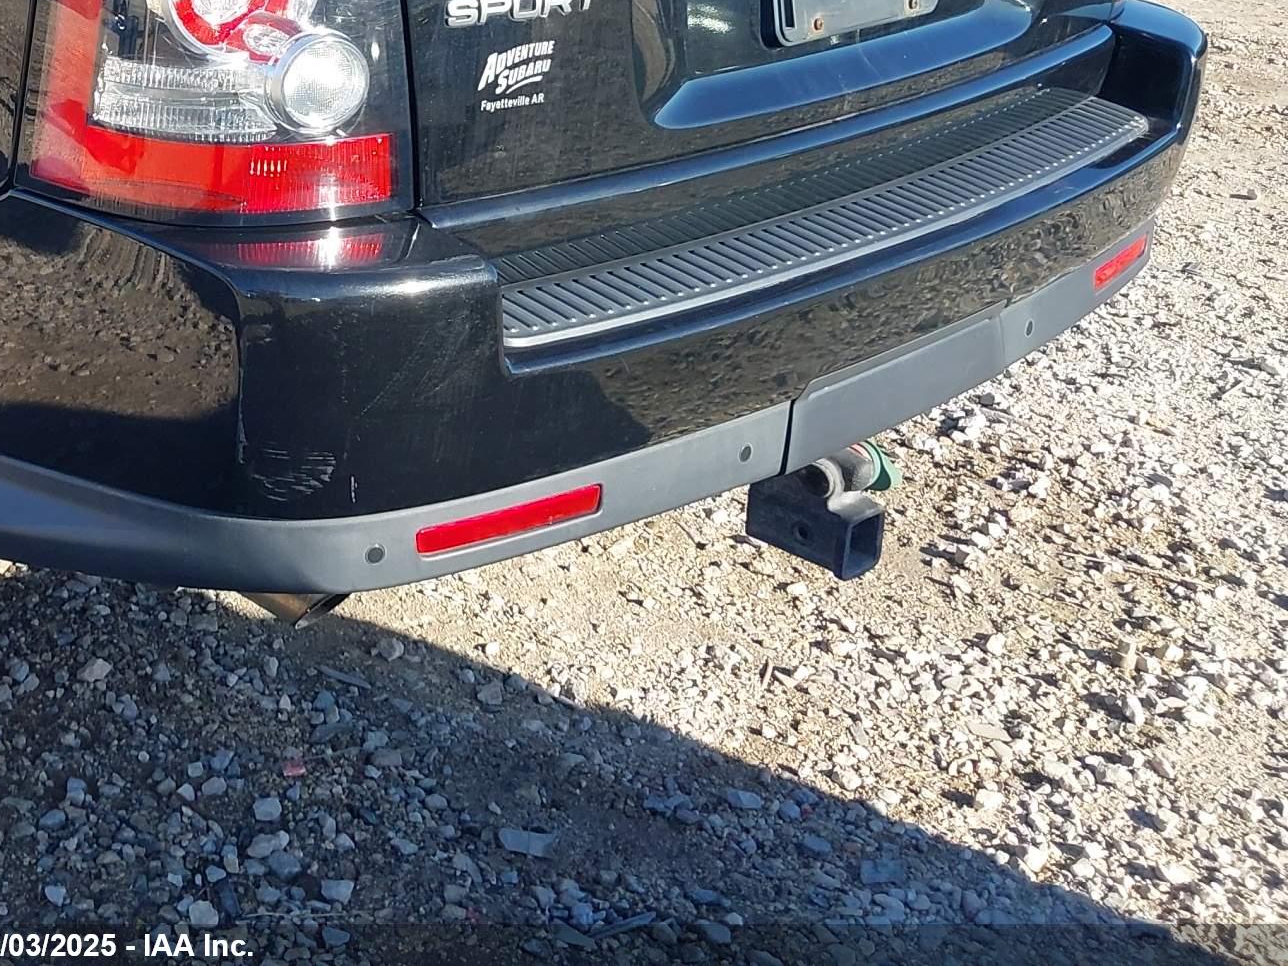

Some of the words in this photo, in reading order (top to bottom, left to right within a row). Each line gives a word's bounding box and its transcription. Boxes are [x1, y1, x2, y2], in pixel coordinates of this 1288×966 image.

[477, 40, 555, 91] ADVENTURE
[495, 59, 552, 94] SUBARU
[480, 95, 530, 113] Fayetteville
[531, 92, 545, 105] AR
